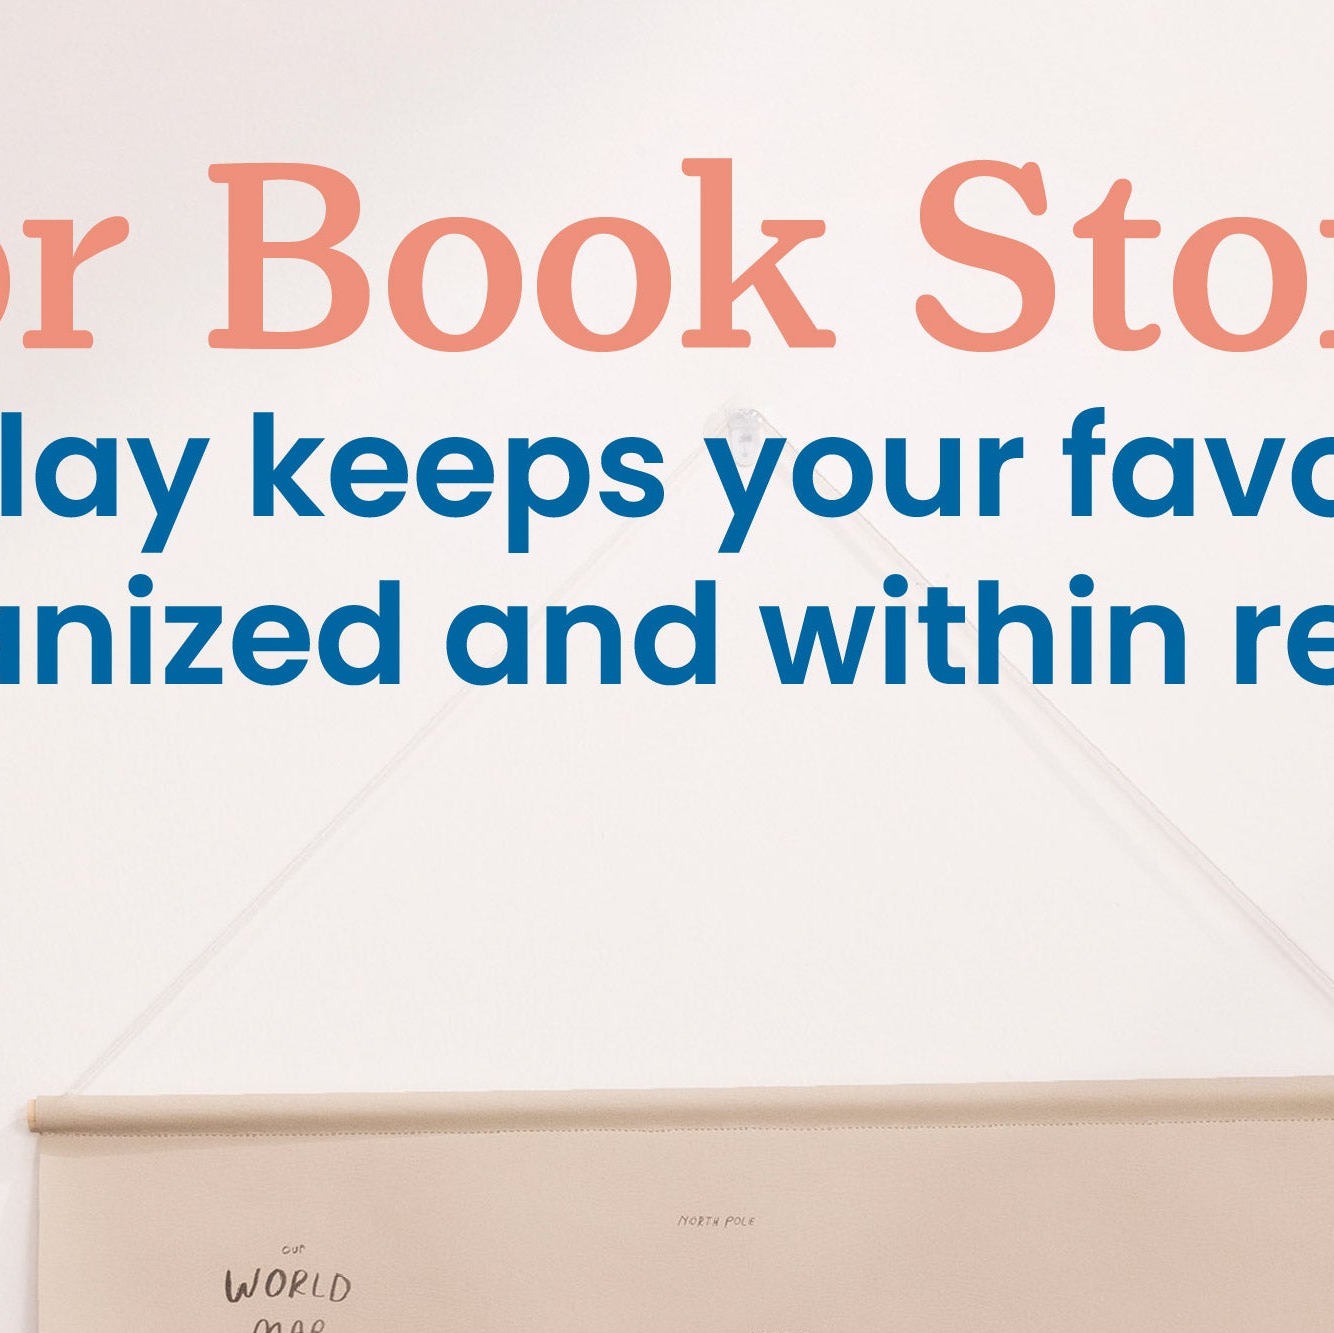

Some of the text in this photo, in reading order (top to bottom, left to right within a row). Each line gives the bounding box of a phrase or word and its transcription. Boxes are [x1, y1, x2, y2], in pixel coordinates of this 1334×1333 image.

[677, 1215, 756, 1227] NORTH POLE
[224, 1268, 352, 1302] WORLD
